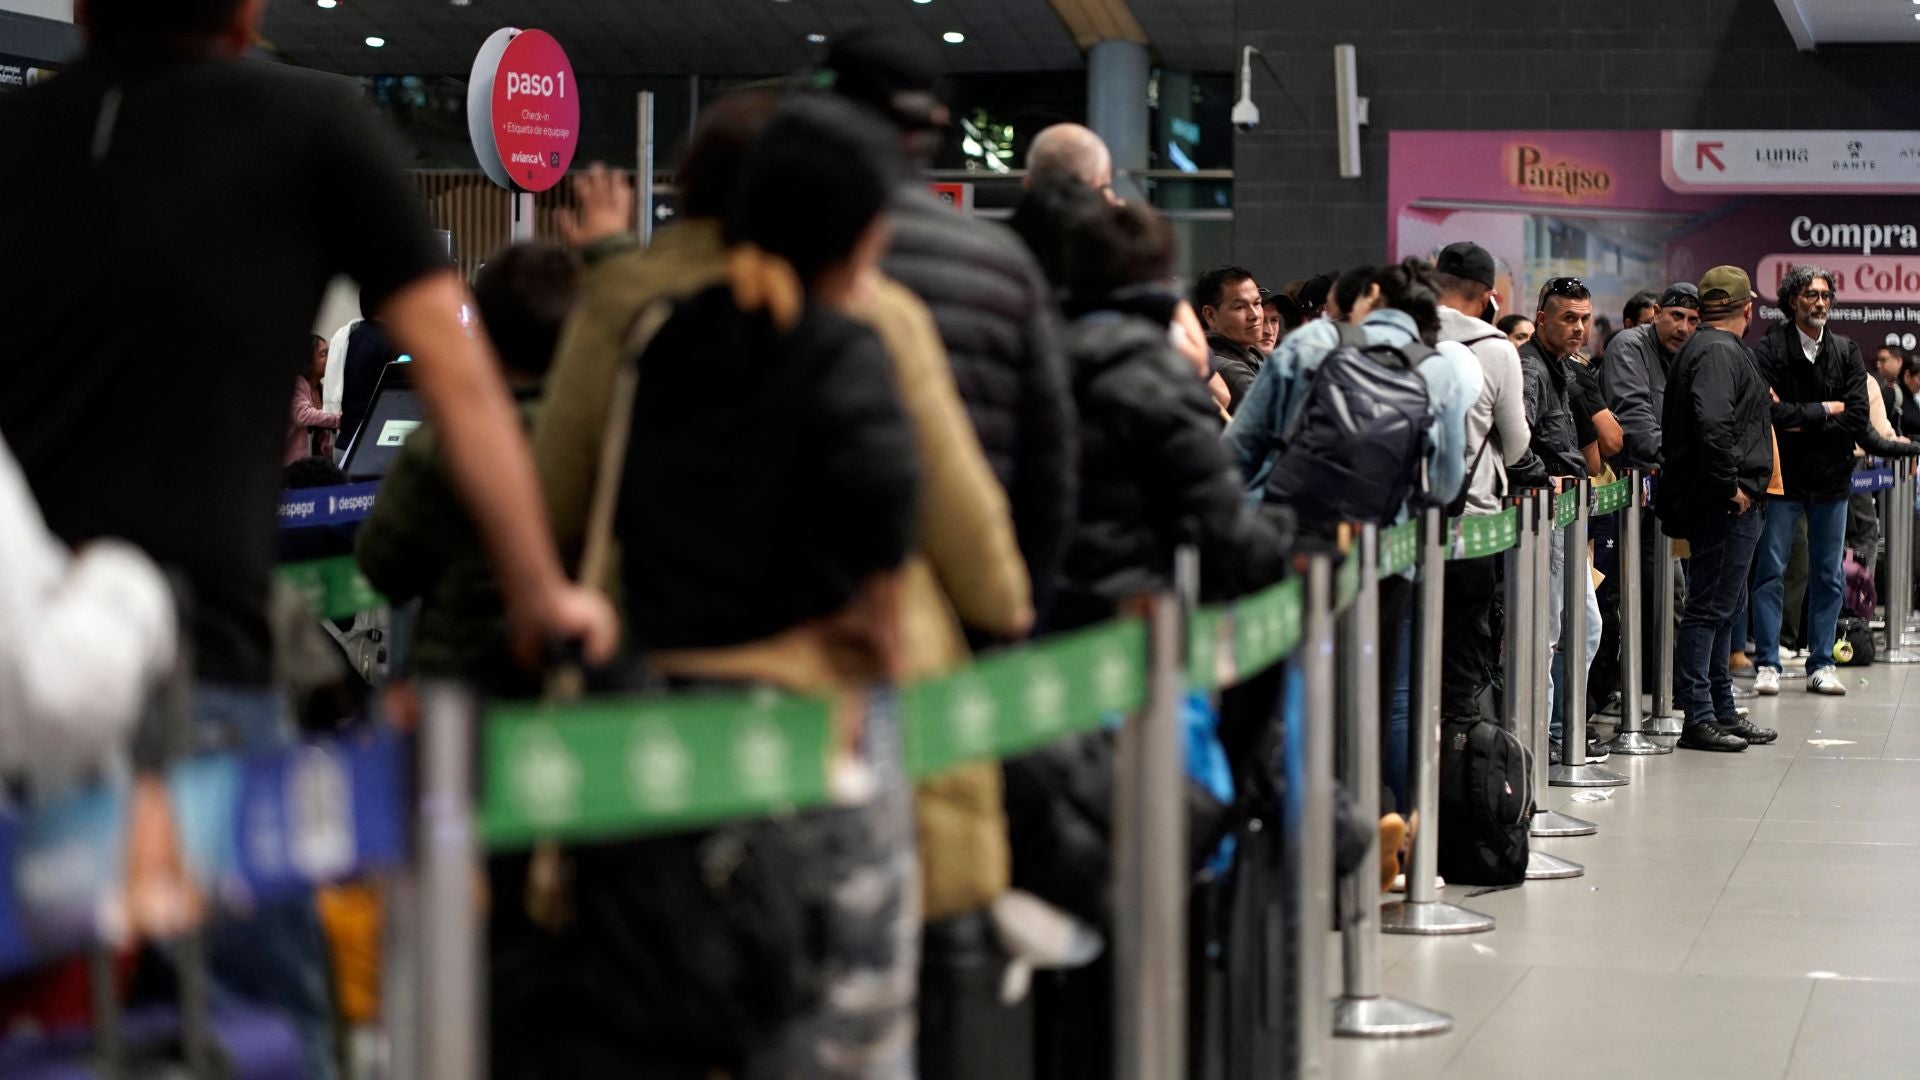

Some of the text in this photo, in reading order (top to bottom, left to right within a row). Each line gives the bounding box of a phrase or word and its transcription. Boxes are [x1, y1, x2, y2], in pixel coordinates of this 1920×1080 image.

[507, 70, 565, 100] paso 1
[521, 109, 550, 120] Check-in
[507, 121, 533, 134] Etiqueta
[534, 125, 543, 135] de
[543, 126, 570, 140] equipaje
[511, 151, 538, 165] avianca
[1790, 215, 1917, 256] Compra
[1894, 306, 1905, 321] al
